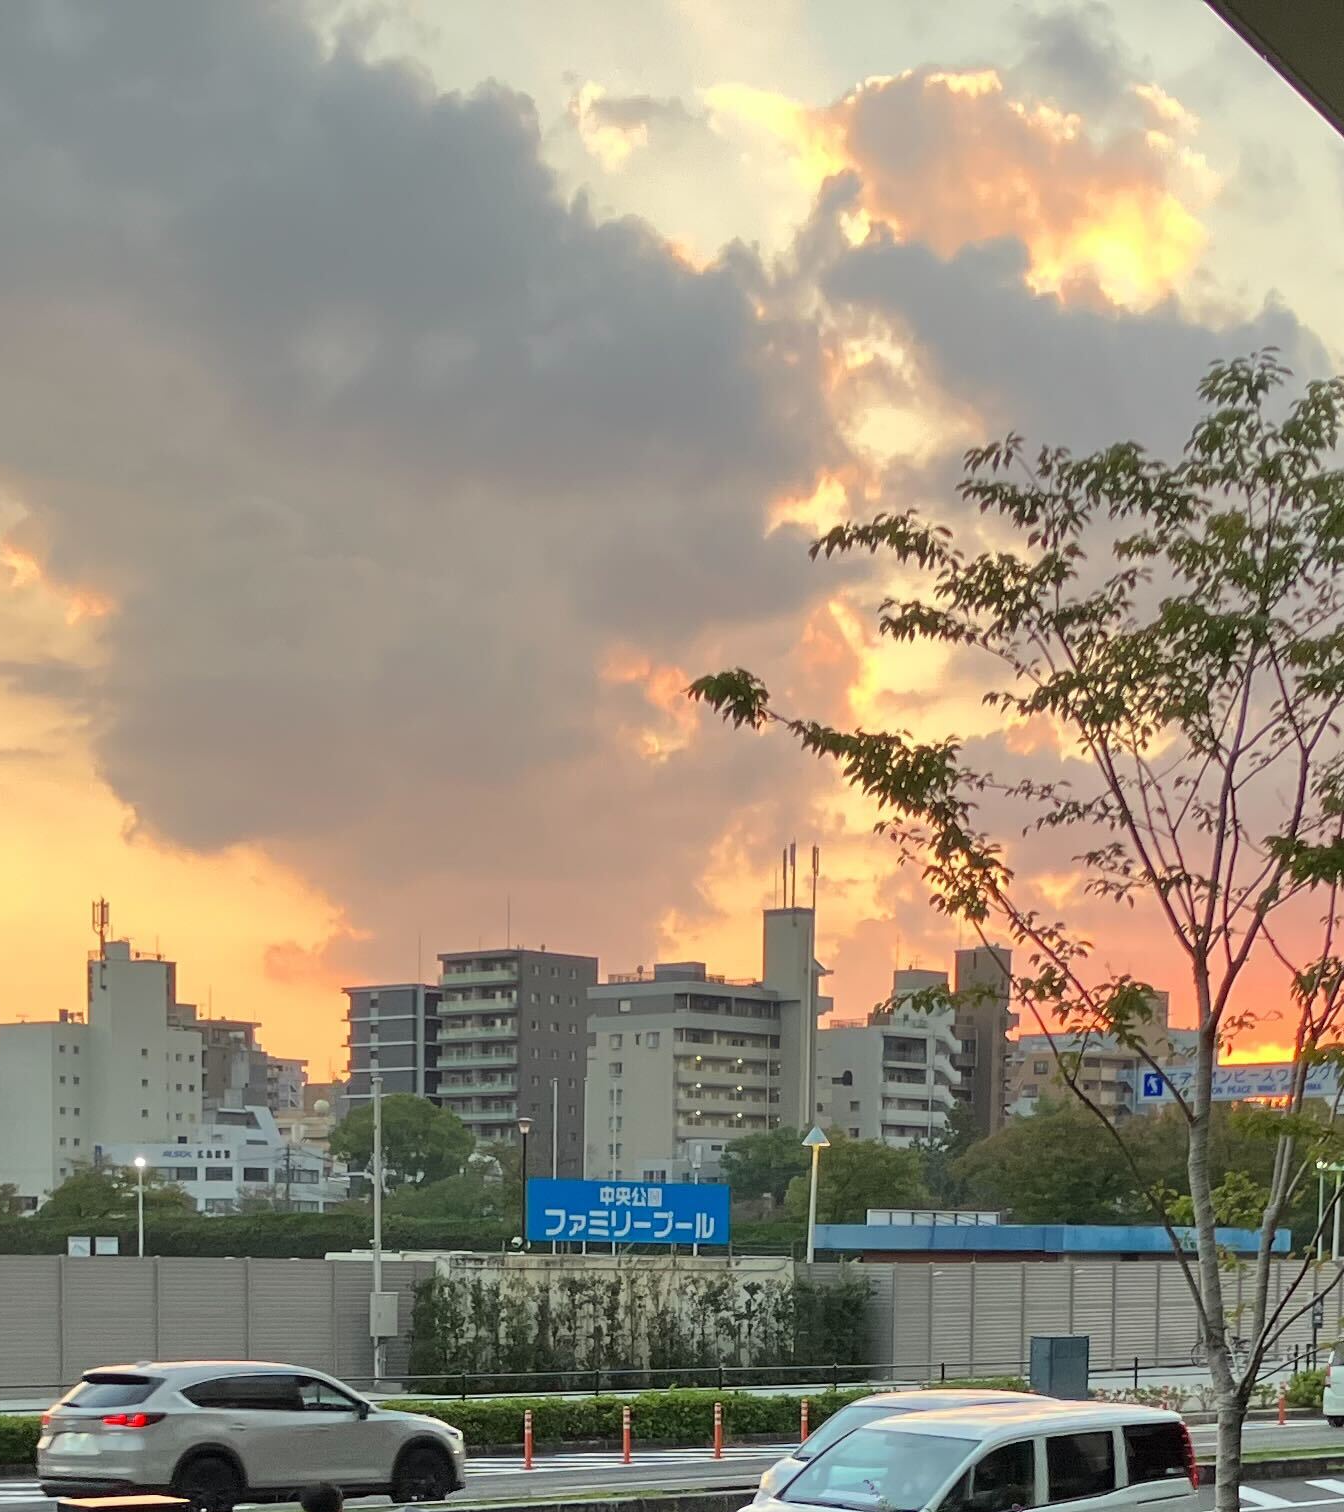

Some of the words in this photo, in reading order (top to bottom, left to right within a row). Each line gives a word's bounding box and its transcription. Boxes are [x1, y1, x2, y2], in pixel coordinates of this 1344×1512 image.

[599, 1185, 663, 1208] 中央公園
[544, 1207, 716, 1240] ファミリープール
